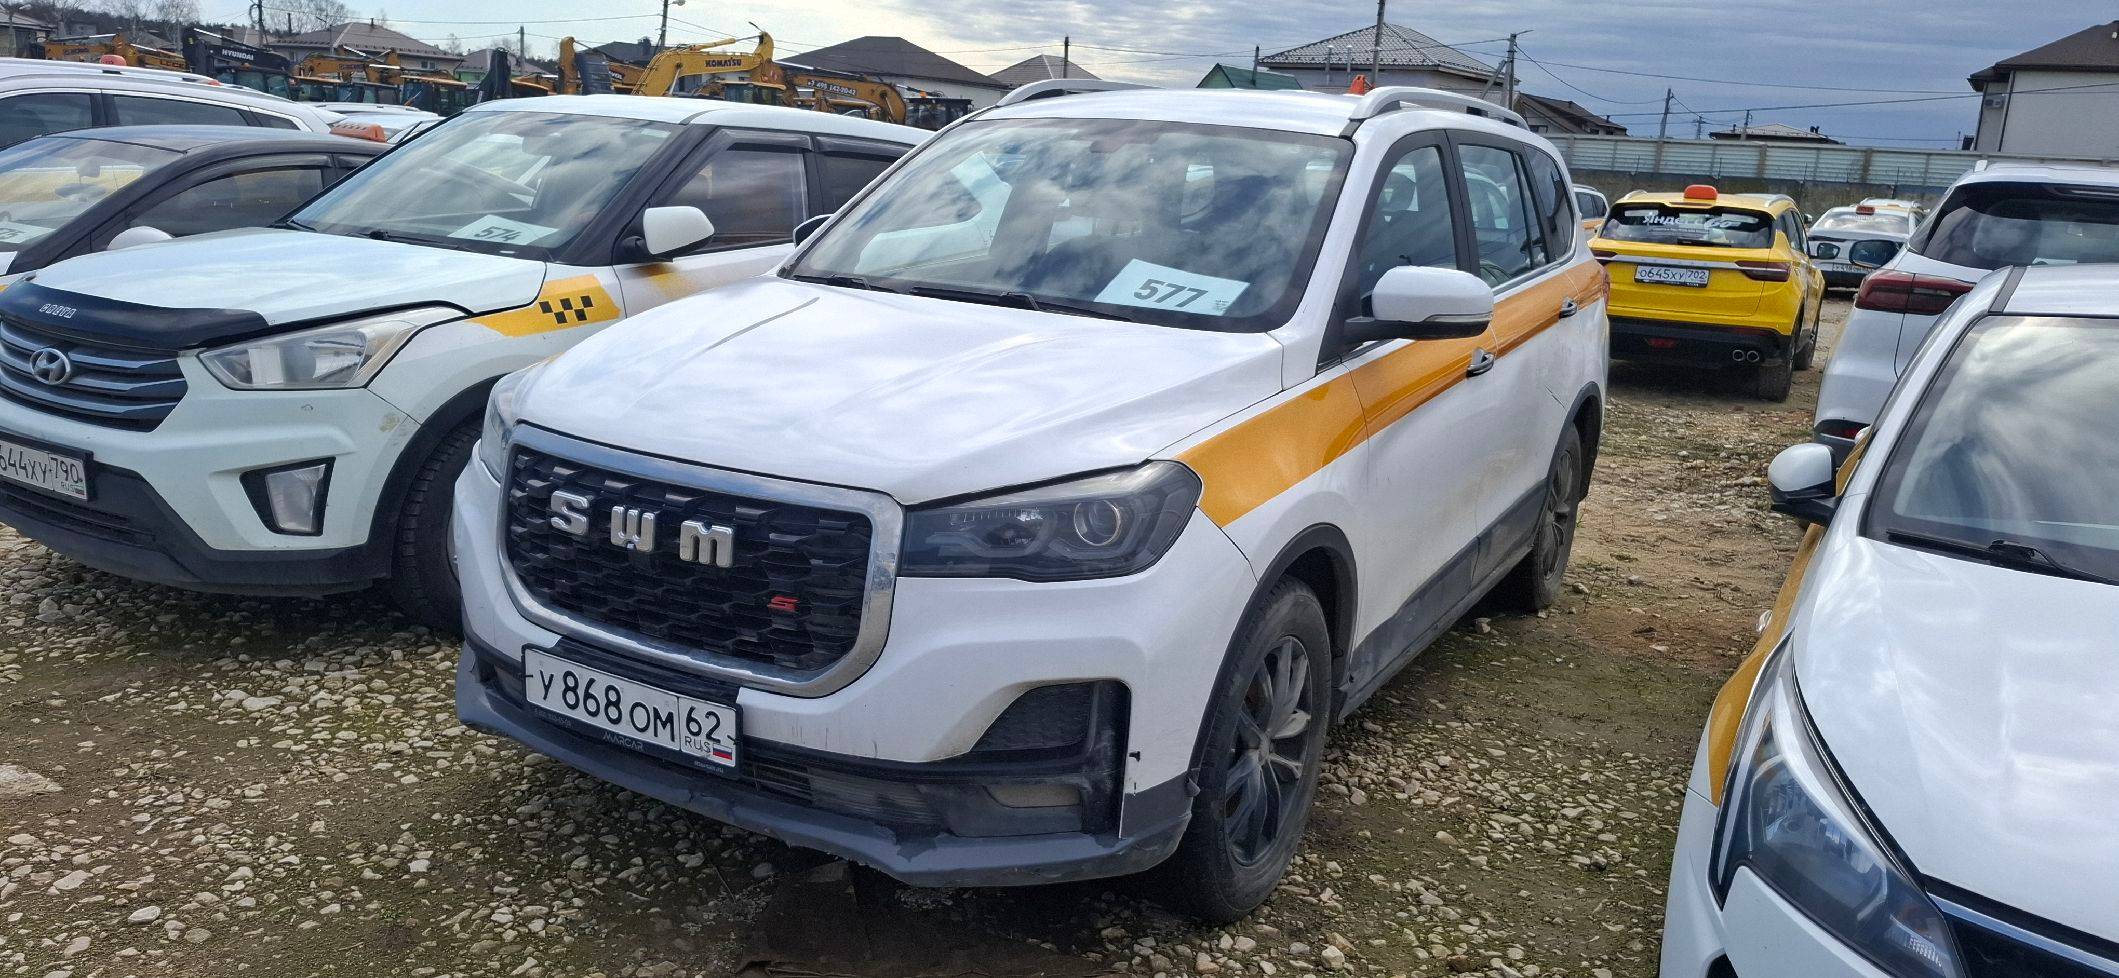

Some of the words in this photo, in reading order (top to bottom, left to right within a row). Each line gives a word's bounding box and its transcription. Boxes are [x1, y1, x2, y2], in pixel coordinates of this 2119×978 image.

[222, 49, 254, 60] HYUNDAI
[705, 59, 742, 67] KOMATSU
[1642, 211, 1703, 226] Янде
[474, 226, 522, 242] 574
[1133, 278, 1209, 308] 577
[50, 456, 80, 483] 790
[551, 490, 736, 568] SWM
[686, 706, 721, 744] 62
[684, 735, 711, 753] RUS
